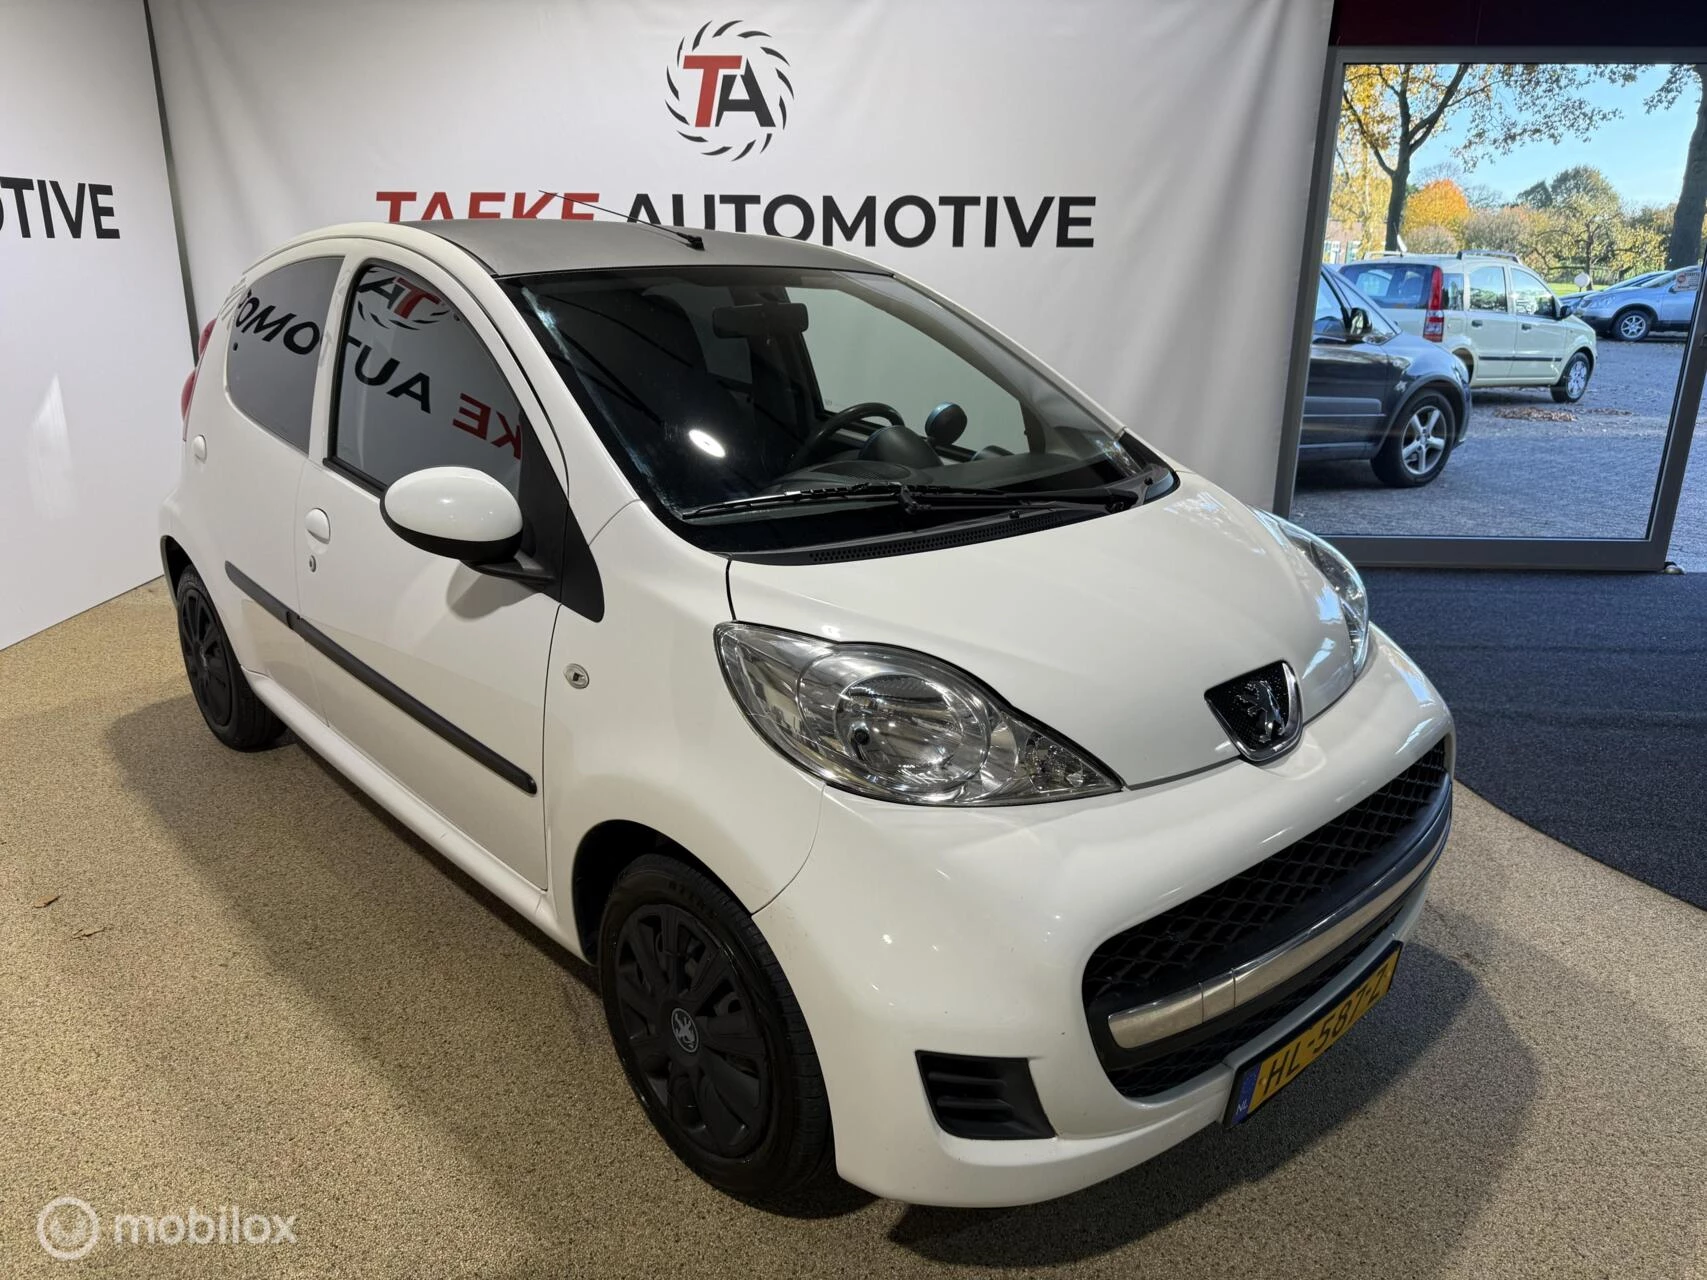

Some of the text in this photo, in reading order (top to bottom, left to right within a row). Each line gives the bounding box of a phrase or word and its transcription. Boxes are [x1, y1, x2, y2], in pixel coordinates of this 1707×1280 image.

[683, 55, 776, 128] TA
[0, 176, 120, 239] TIVE
[627, 193, 1096, 248] AUTOMOTIVE
[1264, 963, 1389, 1096] HL-587-Z
